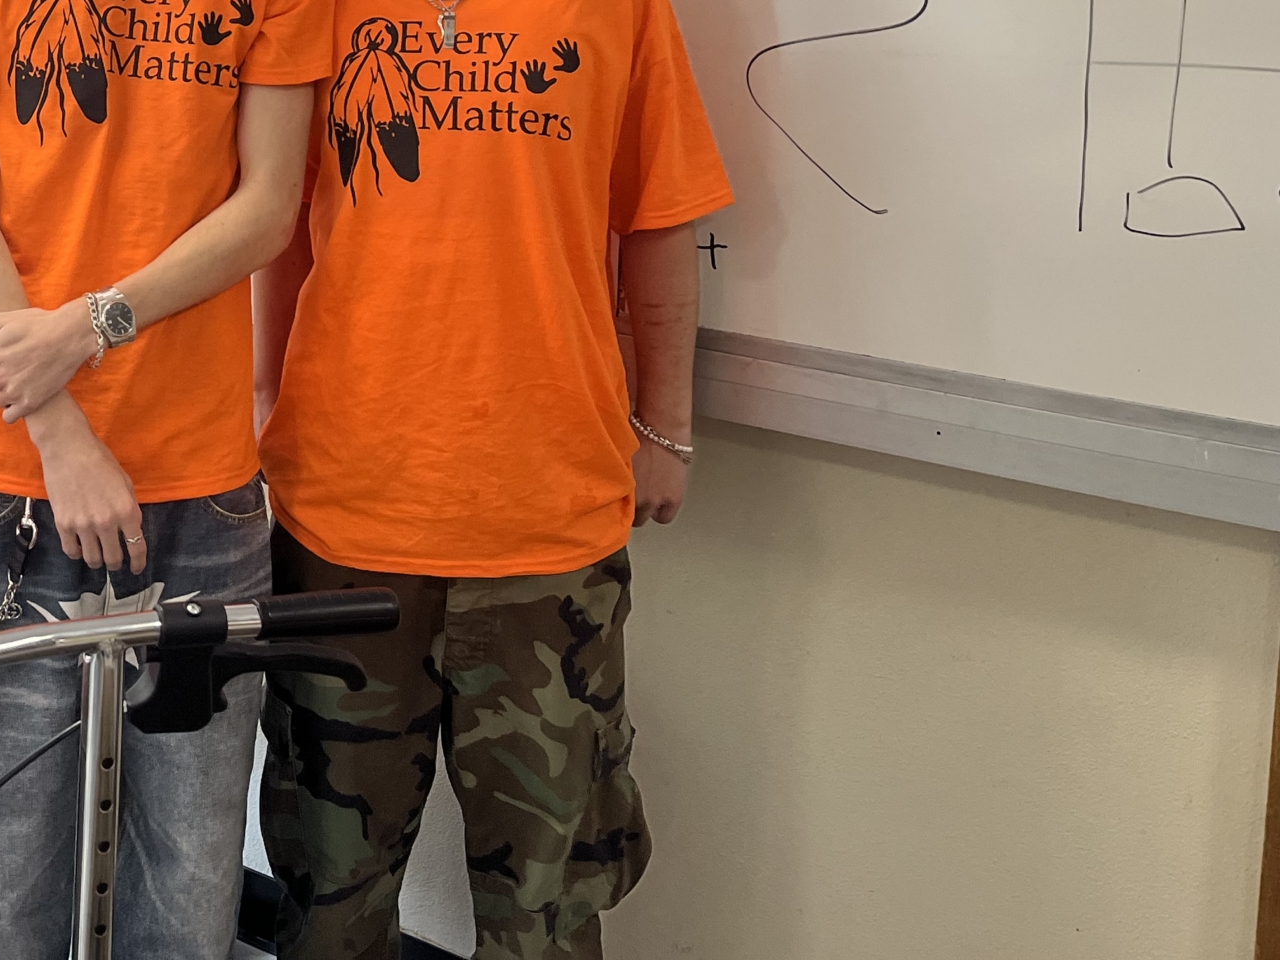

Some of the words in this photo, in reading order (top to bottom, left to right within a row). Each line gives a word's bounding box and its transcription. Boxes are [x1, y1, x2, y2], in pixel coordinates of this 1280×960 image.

[102, 5, 196, 45] Child
[398, 20, 520, 66] Every
[106, 39, 239, 89] Matters
[412, 60, 520, 93] Child
[418, 96, 573, 141] Matters
